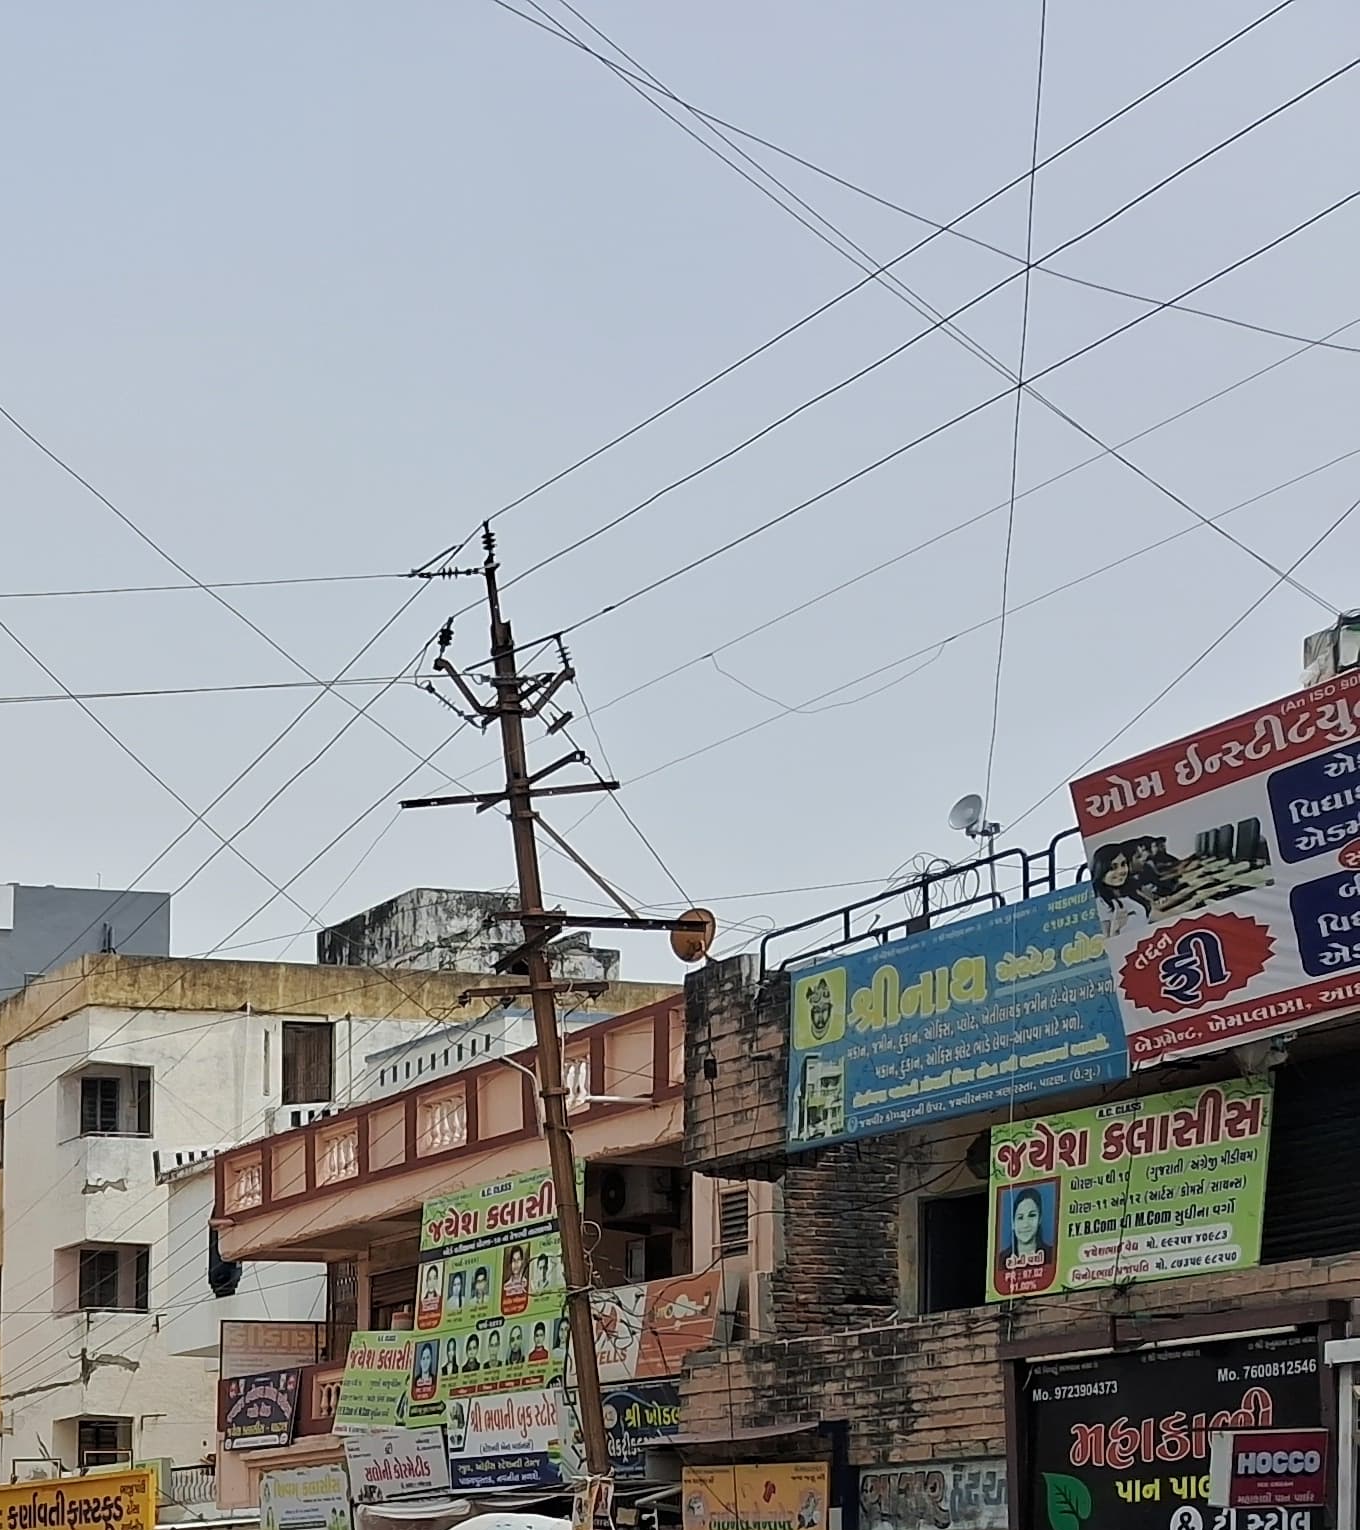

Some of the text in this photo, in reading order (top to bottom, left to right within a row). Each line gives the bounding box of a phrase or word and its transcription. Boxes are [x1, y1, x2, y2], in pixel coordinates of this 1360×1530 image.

[1310, 685, 1335, 701] ISO
[1085, 770, 1165, 817] ઓમ
[848, 956, 988, 1032] શ્રીનાથ
[1116, 1101, 1142, 1115] CLASS
[997, 1087, 1264, 1178] જયેશ કલાસીસ
[428, 1207, 479, 1243] જયેશ
[1134, 1209, 1171, 1228] M.Com
[1217, 1358, 1317, 1383] Mo. 7600812546
[1032, 1380, 1118, 1402] Mo. 9723904373
[470, 1401, 483, 1433] શ્રી
[484, 1397, 515, 1432] ભવાની
[517, 1404, 533, 1438] બુક
[625, 1403, 641, 1428] શ્રી
[1237, 1450, 1321, 1475] HOCCO
[1115, 1476, 1161, 1503] પાન
